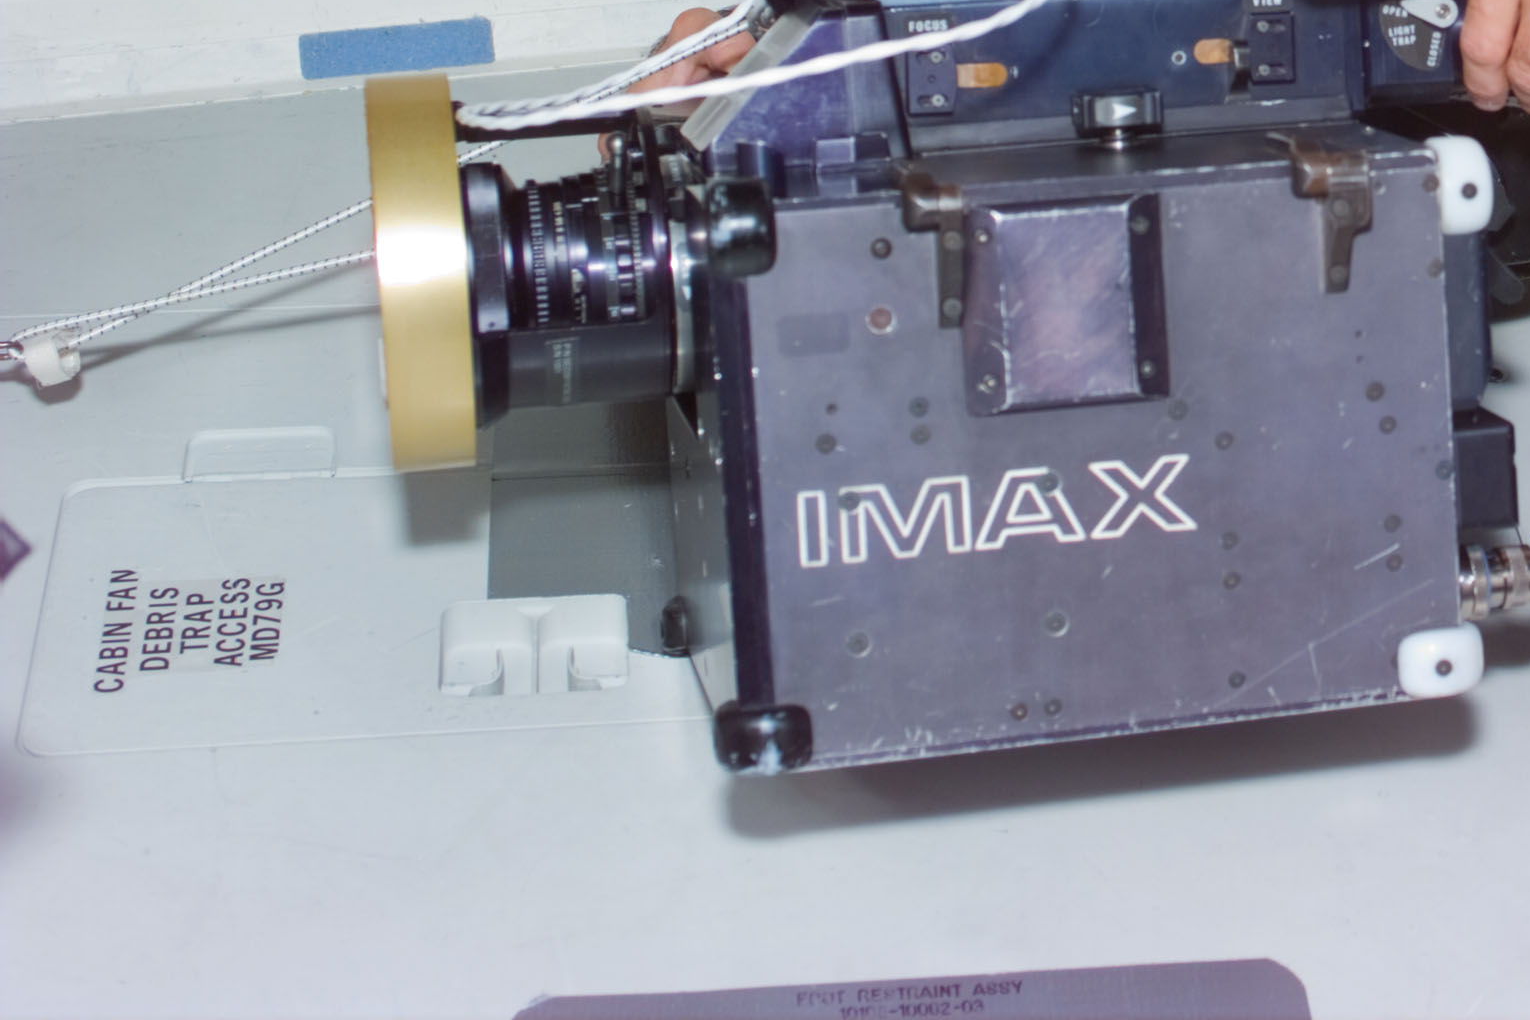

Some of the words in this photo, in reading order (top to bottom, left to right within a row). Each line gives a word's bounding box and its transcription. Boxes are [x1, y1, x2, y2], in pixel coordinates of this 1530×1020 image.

[907, 19, 949, 33] FOCUS
[1382, 5, 1408, 18] OPEN
[1388, 24, 1416, 37] LIGHT
[1392, 35, 1417, 47] TRAP
[1427, 31, 1442, 67] CLOSED
[797, 453, 1198, 568] IMAX
[105, 569, 139, 612] FAN
[139, 587, 180, 671] DEBRIS
[179, 593, 215, 655] TRAP
[213, 578, 251, 667] ACCESS
[249, 582, 285, 661] MD79G
[93, 623, 133, 693] CABIN
[972, 980, 1022, 996] ASSY
